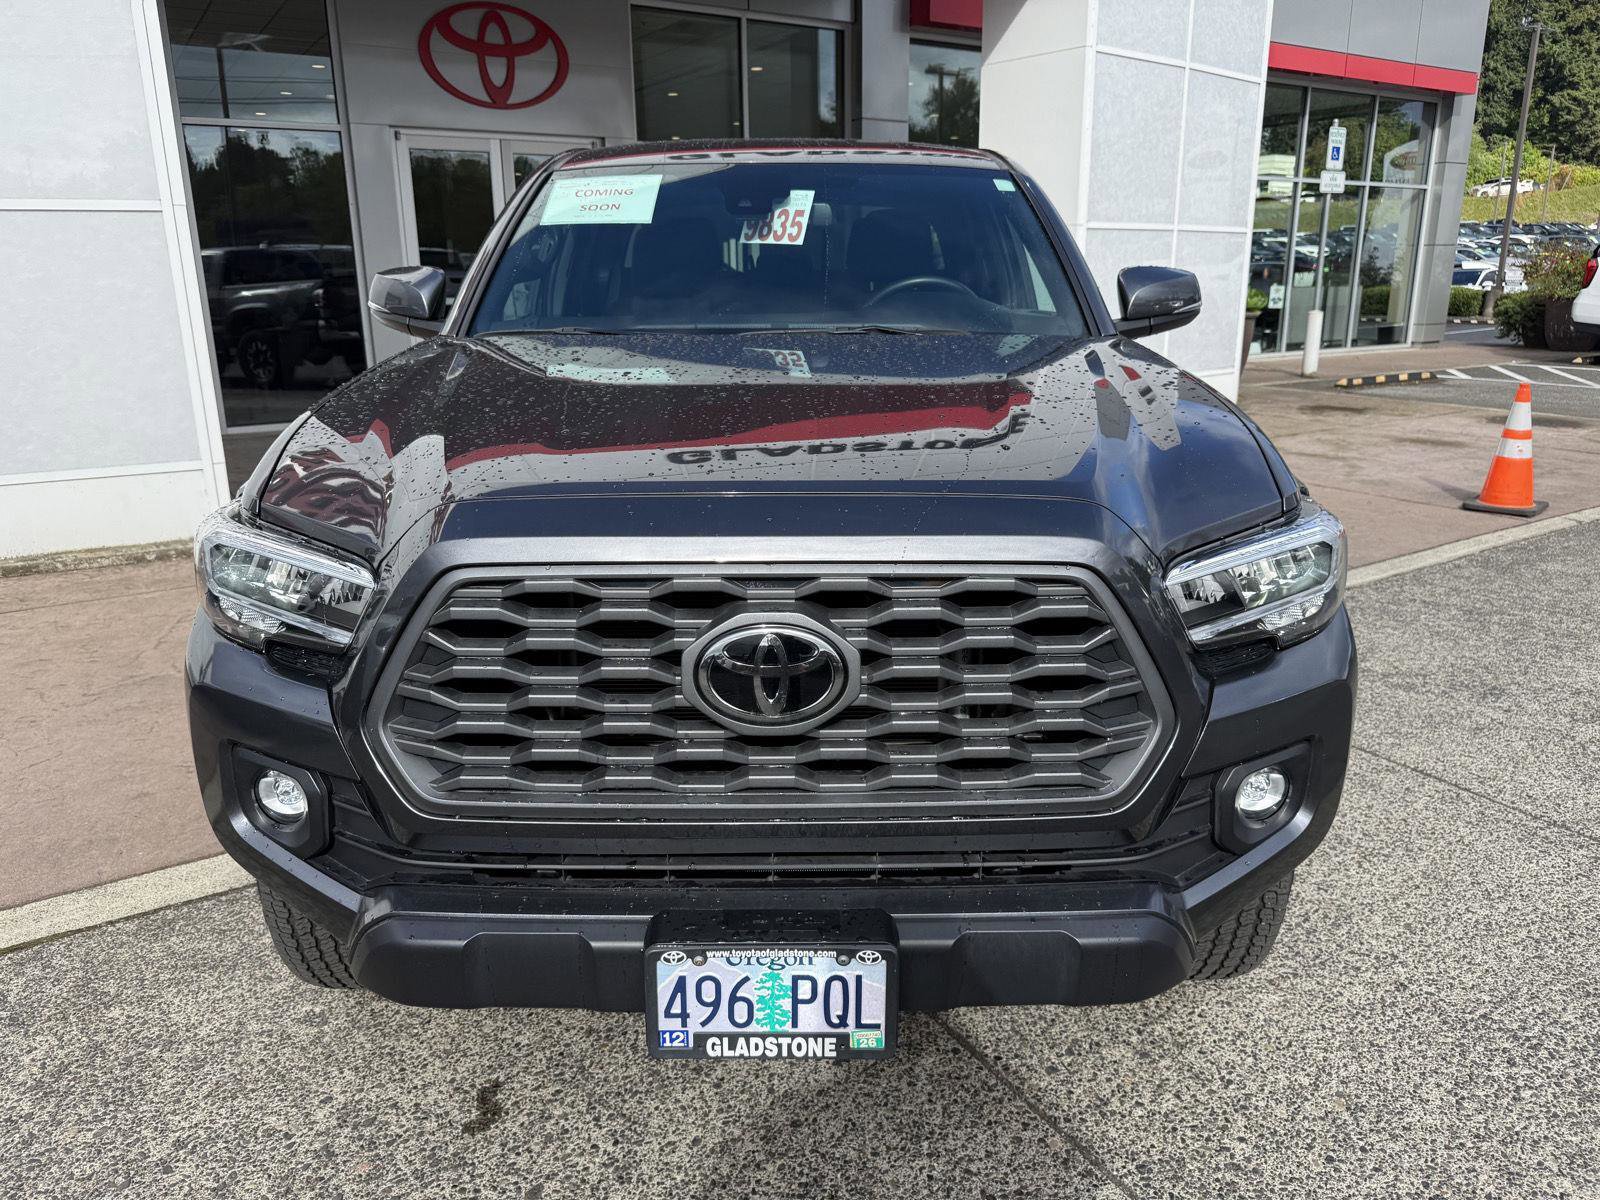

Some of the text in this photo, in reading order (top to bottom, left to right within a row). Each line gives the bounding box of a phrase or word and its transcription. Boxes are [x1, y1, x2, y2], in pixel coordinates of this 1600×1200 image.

[575, 188, 634, 198] COMING
[579, 203, 621, 212] SOON
[706, 948, 837, 961] www.toyotaofgladstone.com
[663, 974, 882, 1029] 496 PQL
[663, 1031, 685, 1047] 12
[859, 1037, 877, 1049] 26
[706, 1036, 837, 1058] GLADSTONE
